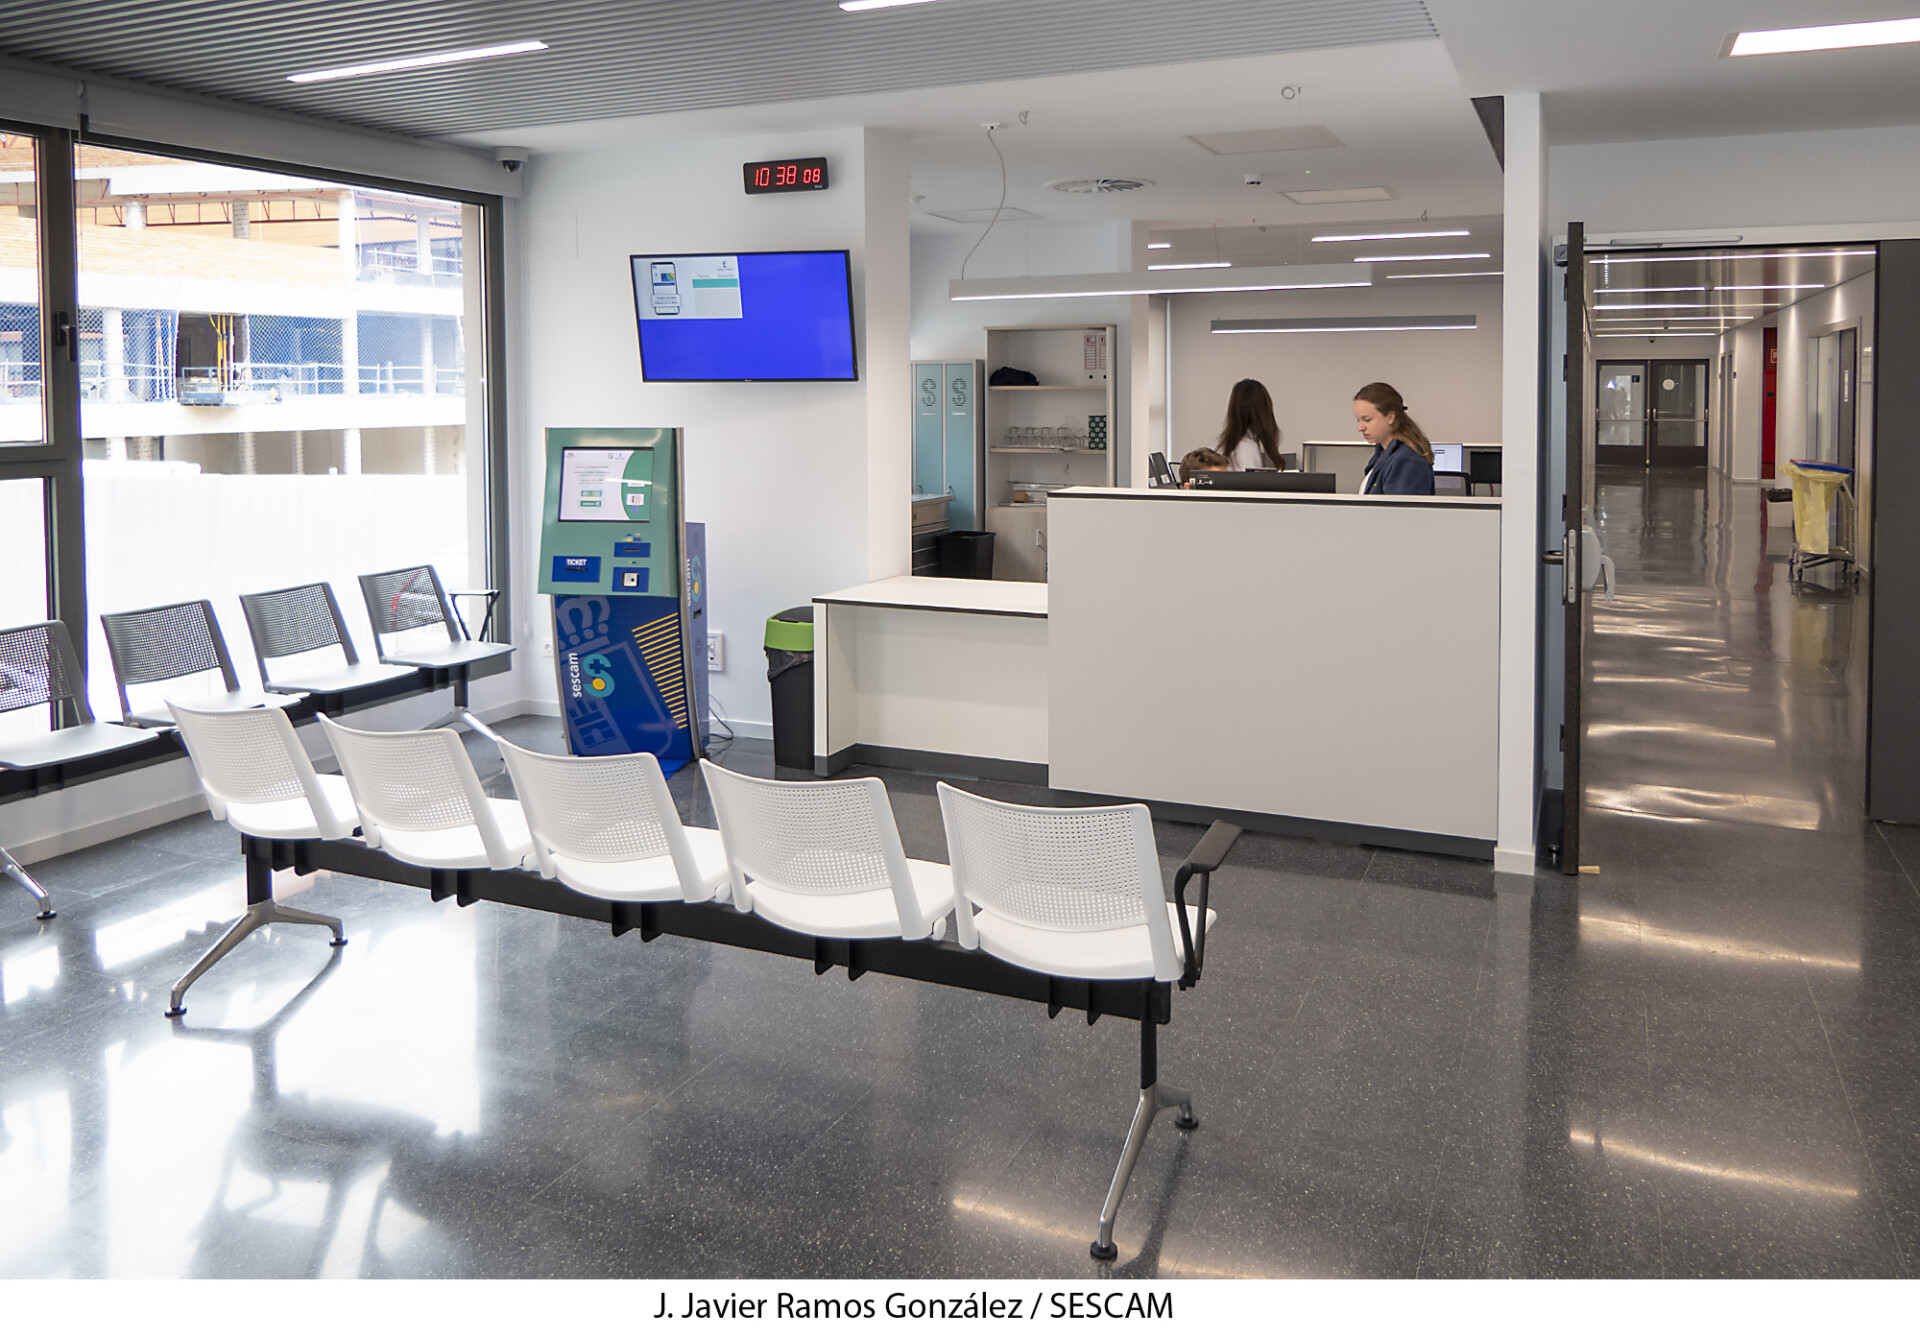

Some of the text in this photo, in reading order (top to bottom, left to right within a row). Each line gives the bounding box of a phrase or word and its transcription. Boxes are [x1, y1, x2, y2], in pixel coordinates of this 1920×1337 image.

[755, 165, 821, 187] 10 38 08
[566, 558, 587, 566] TICKET
[568, 652, 582, 698] sescam
